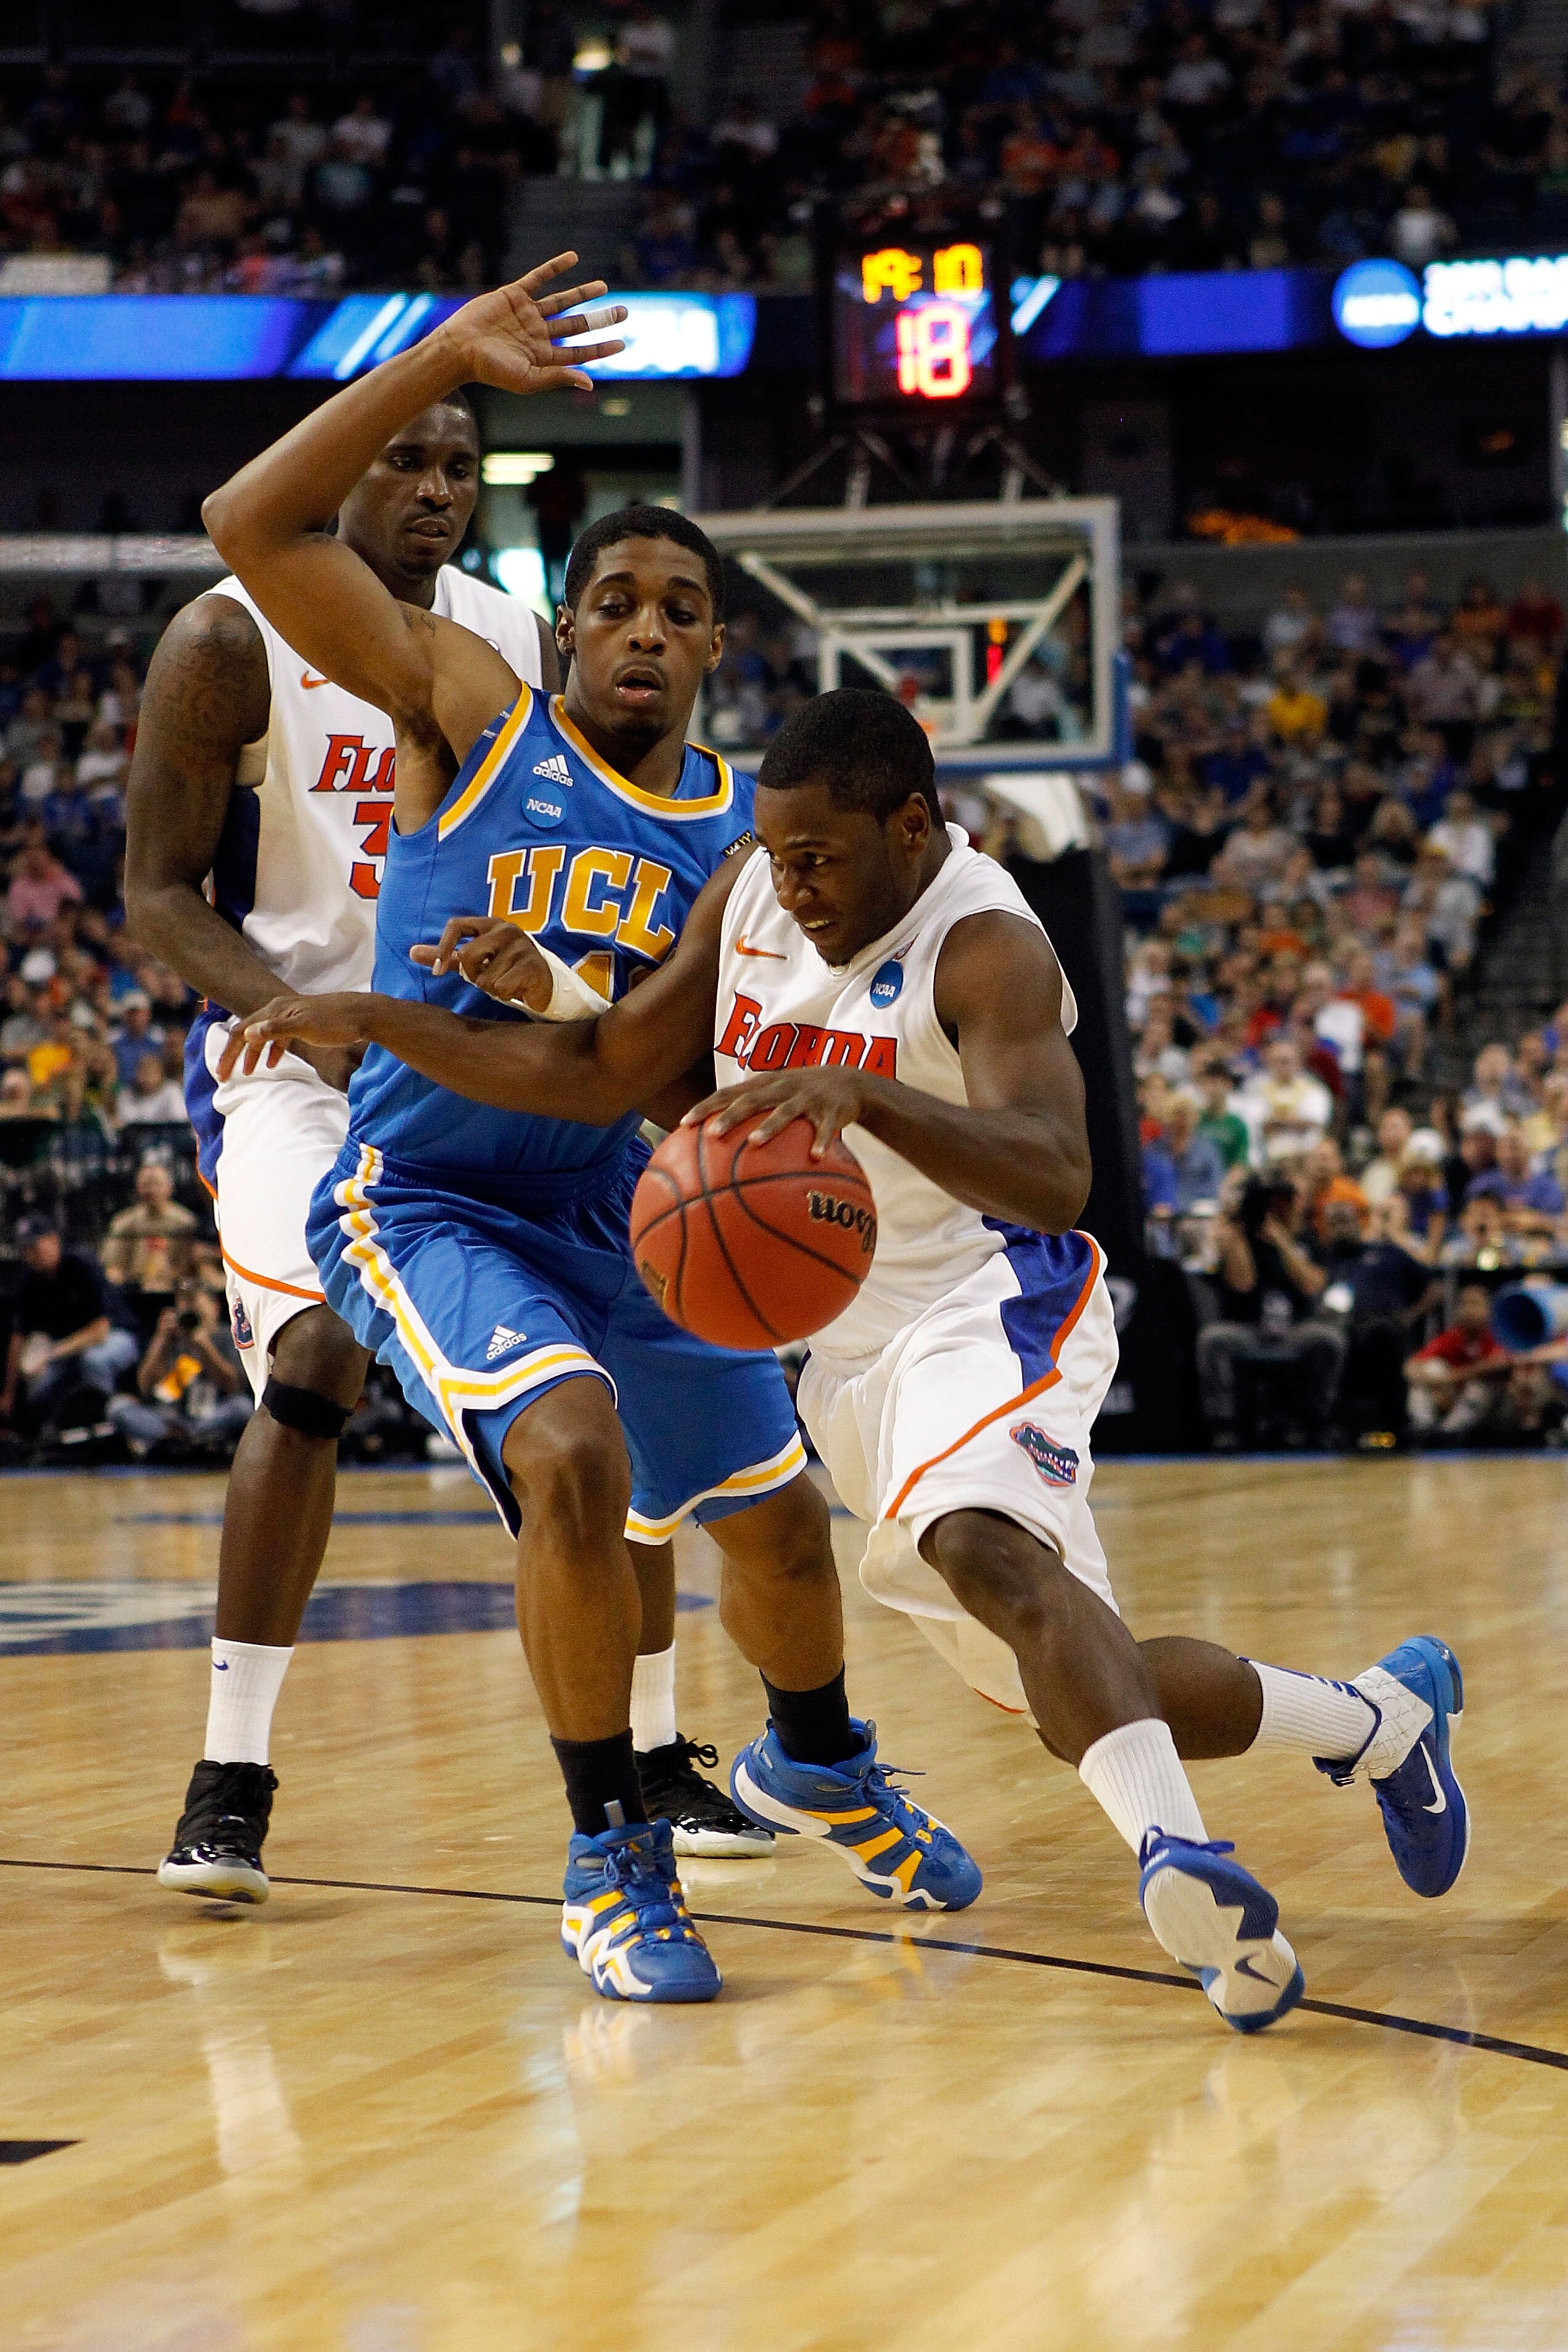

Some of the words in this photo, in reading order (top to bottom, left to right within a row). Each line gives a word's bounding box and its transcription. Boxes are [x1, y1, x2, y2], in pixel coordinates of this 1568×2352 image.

[895, 301, 973, 400] 18
[533, 767, 574, 787] adidas
[526, 798, 562, 818] NCAA
[486, 845, 678, 963] UCL
[872, 983, 896, 998] NCAA
[486, 1333, 527, 1360] adidas
